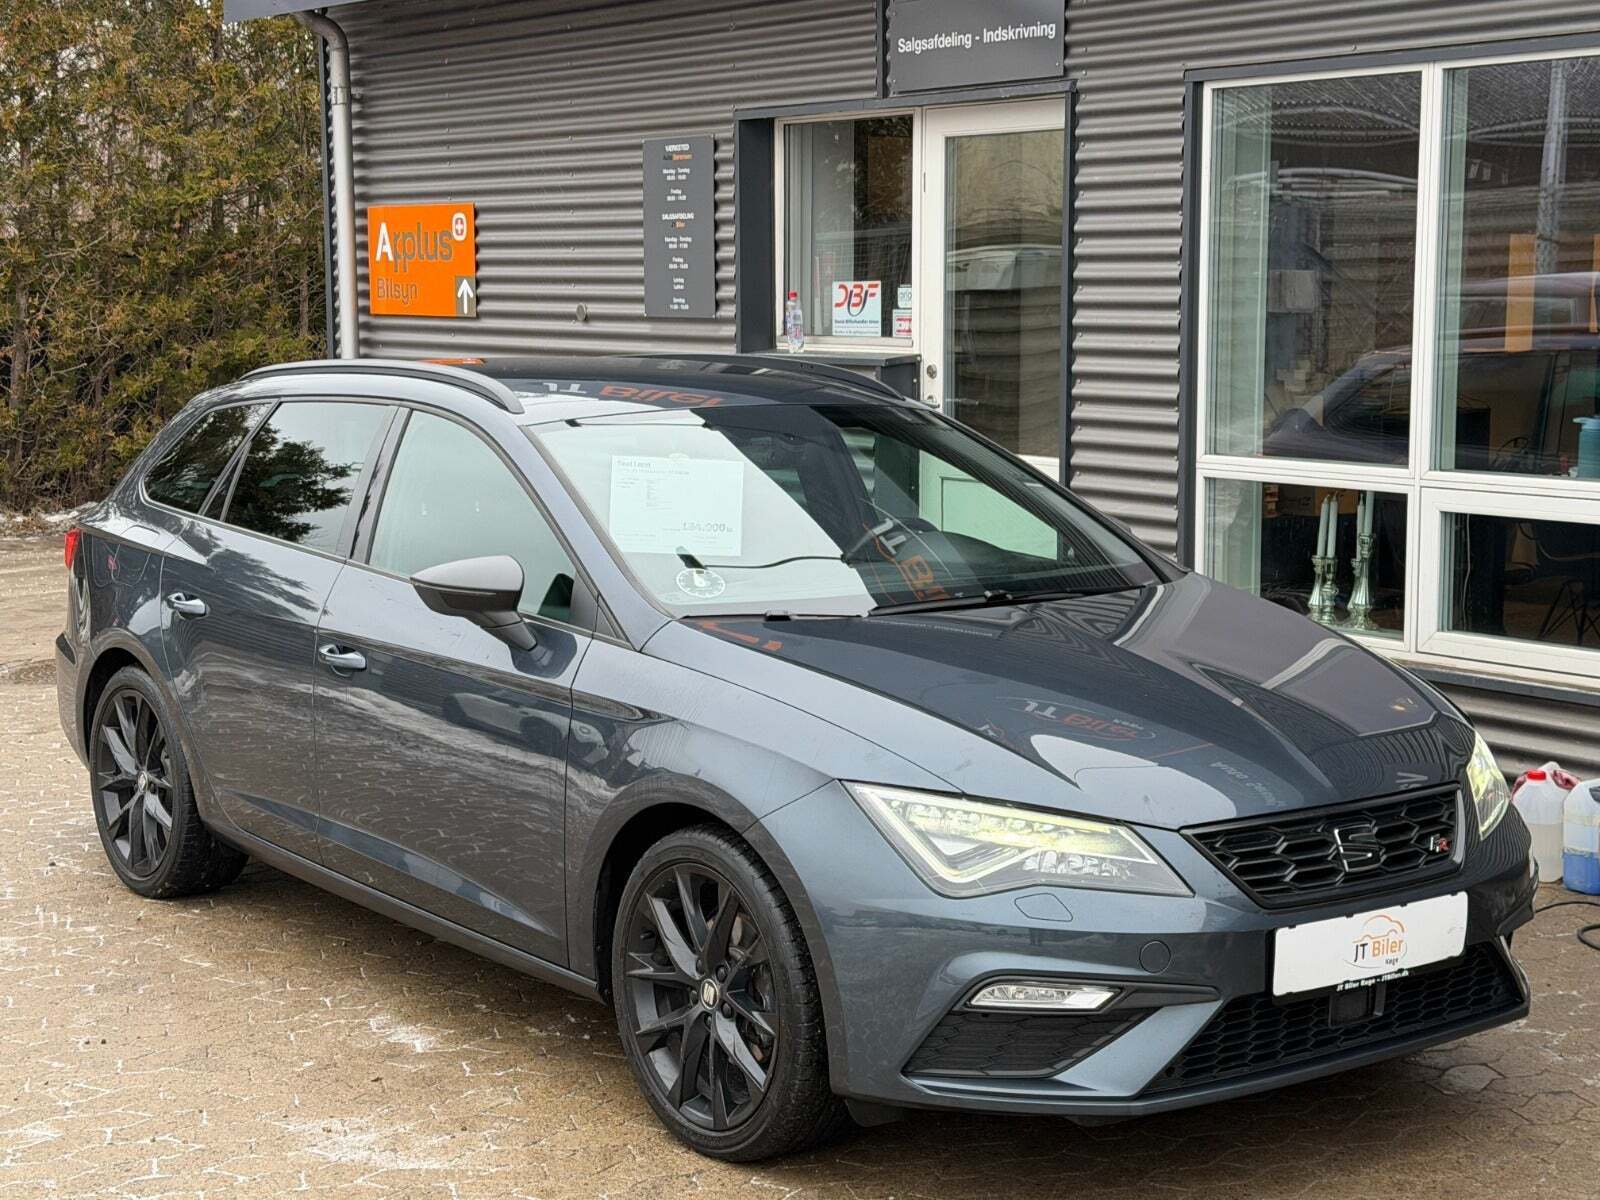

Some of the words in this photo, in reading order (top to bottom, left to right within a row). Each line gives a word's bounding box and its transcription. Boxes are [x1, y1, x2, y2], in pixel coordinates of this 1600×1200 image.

[897, 31, 972, 55] Salgsafdeling
[983, 21, 1056, 44] Indskrivning
[377, 278, 418, 305] Bilsyn
[1353, 943, 1369, 962] JT
[1371, 938, 1405, 958] Biler
